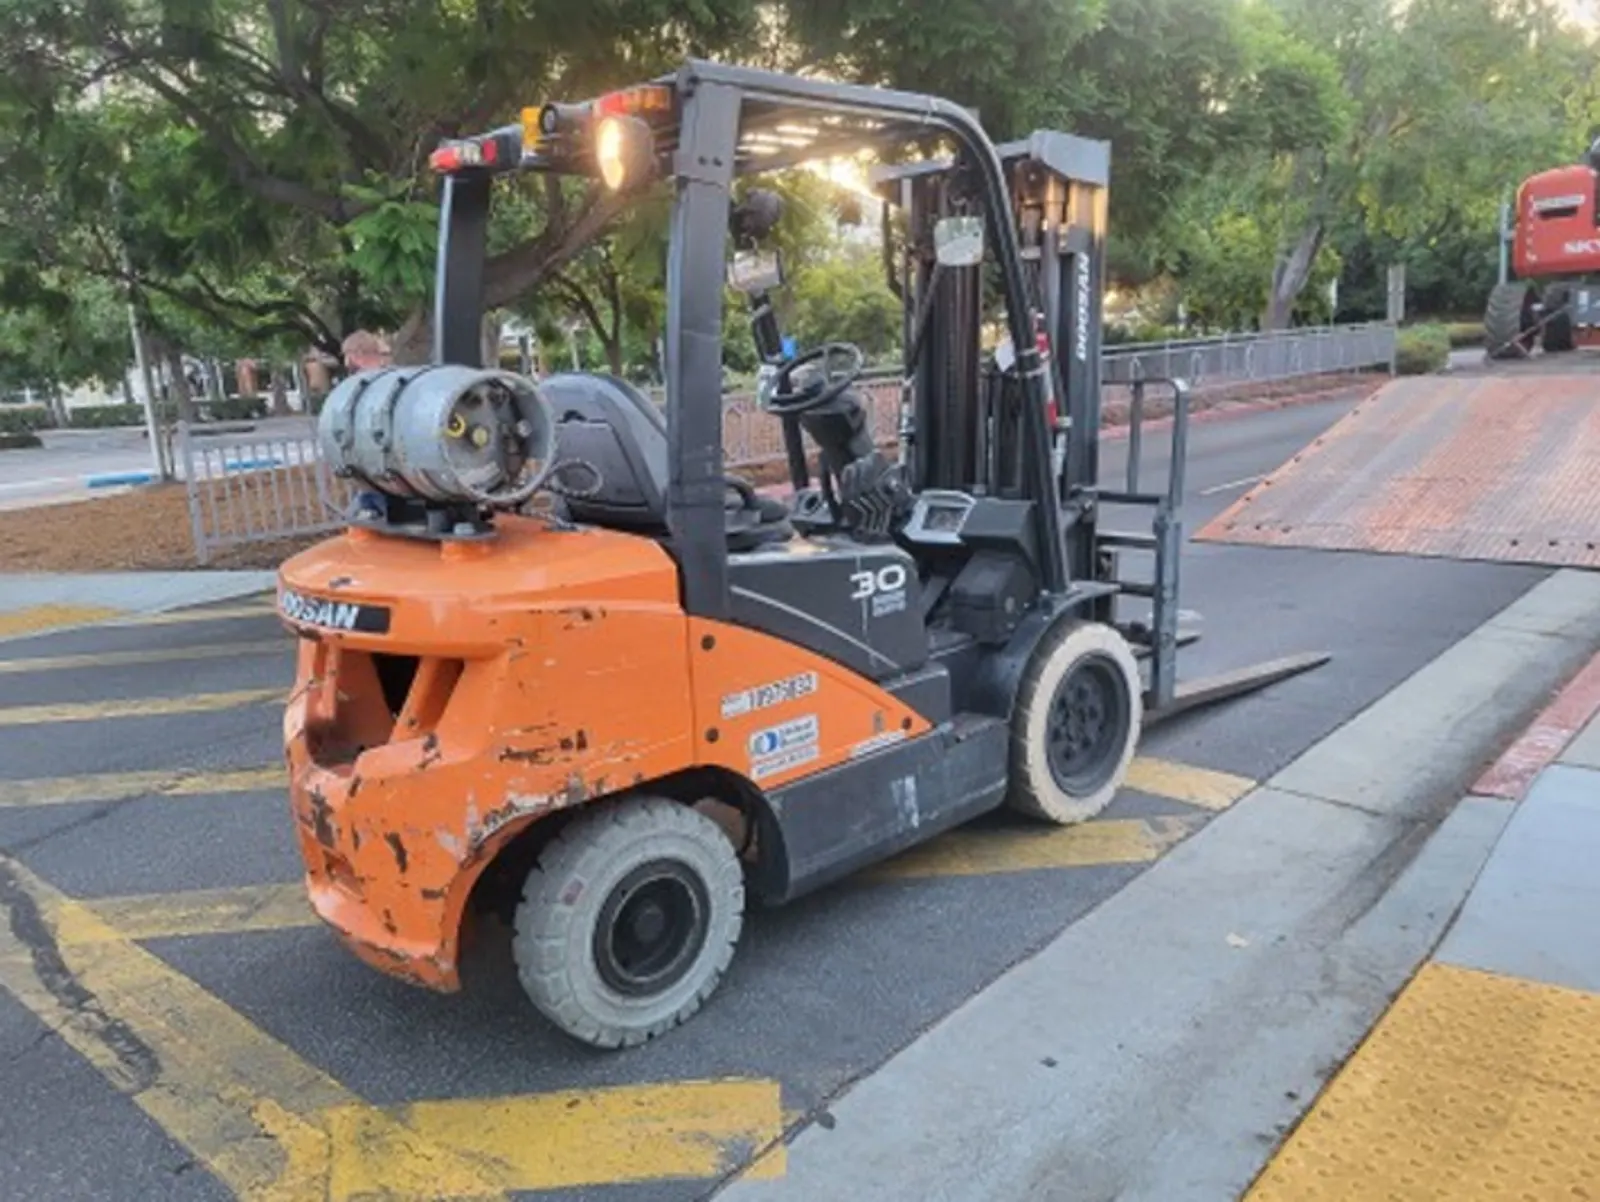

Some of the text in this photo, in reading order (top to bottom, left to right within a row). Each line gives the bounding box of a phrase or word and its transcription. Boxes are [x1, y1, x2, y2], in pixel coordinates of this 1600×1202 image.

[1076, 252, 1089, 360] DOOSAN
[850, 565, 906, 600] 30
[283, 591, 359, 629] OOSAN
